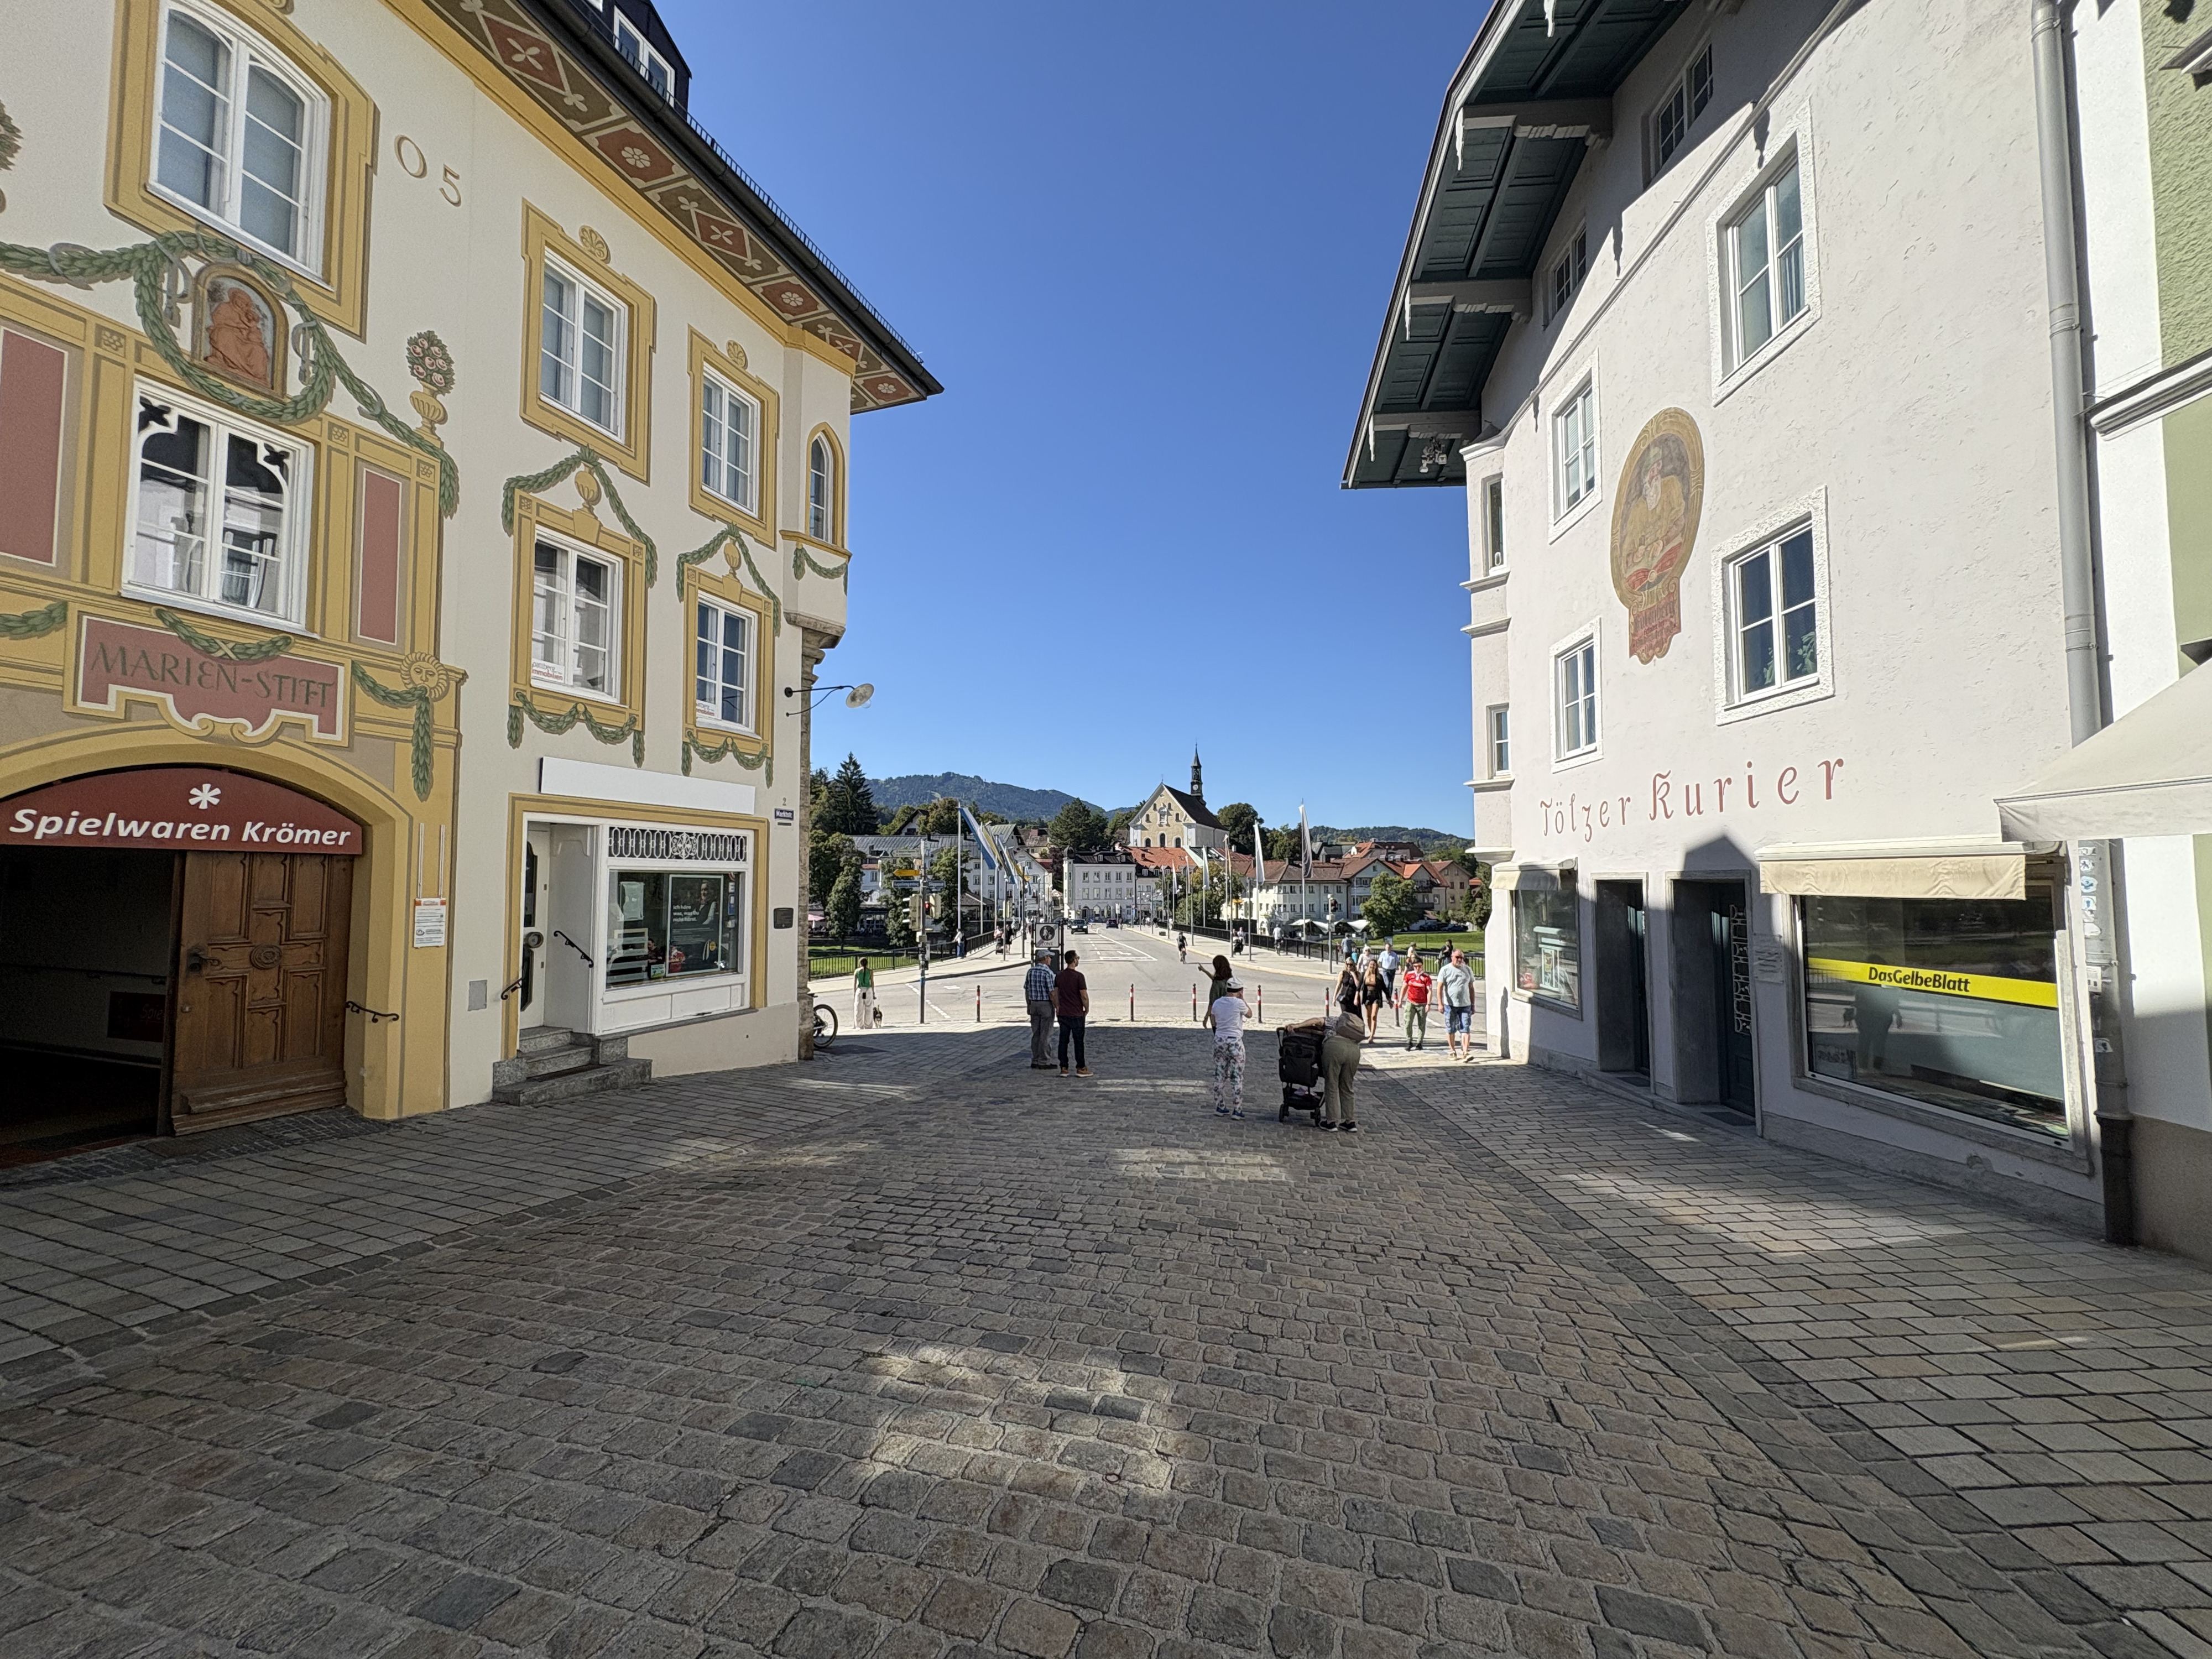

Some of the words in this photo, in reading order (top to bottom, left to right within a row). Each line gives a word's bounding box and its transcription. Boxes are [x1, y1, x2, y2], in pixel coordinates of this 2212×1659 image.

[91, 642, 335, 707] MARIEN-STIFT
[782, 797, 787, 806] 2
[1540, 793, 1631, 843] Tölzer
[1649, 758, 1844, 821] Kurier
[9, 809, 230, 841] Spielwaren
[242, 821, 351, 846] Krömer
[1868, 967, 1971, 992] DasGelbeBlatt
